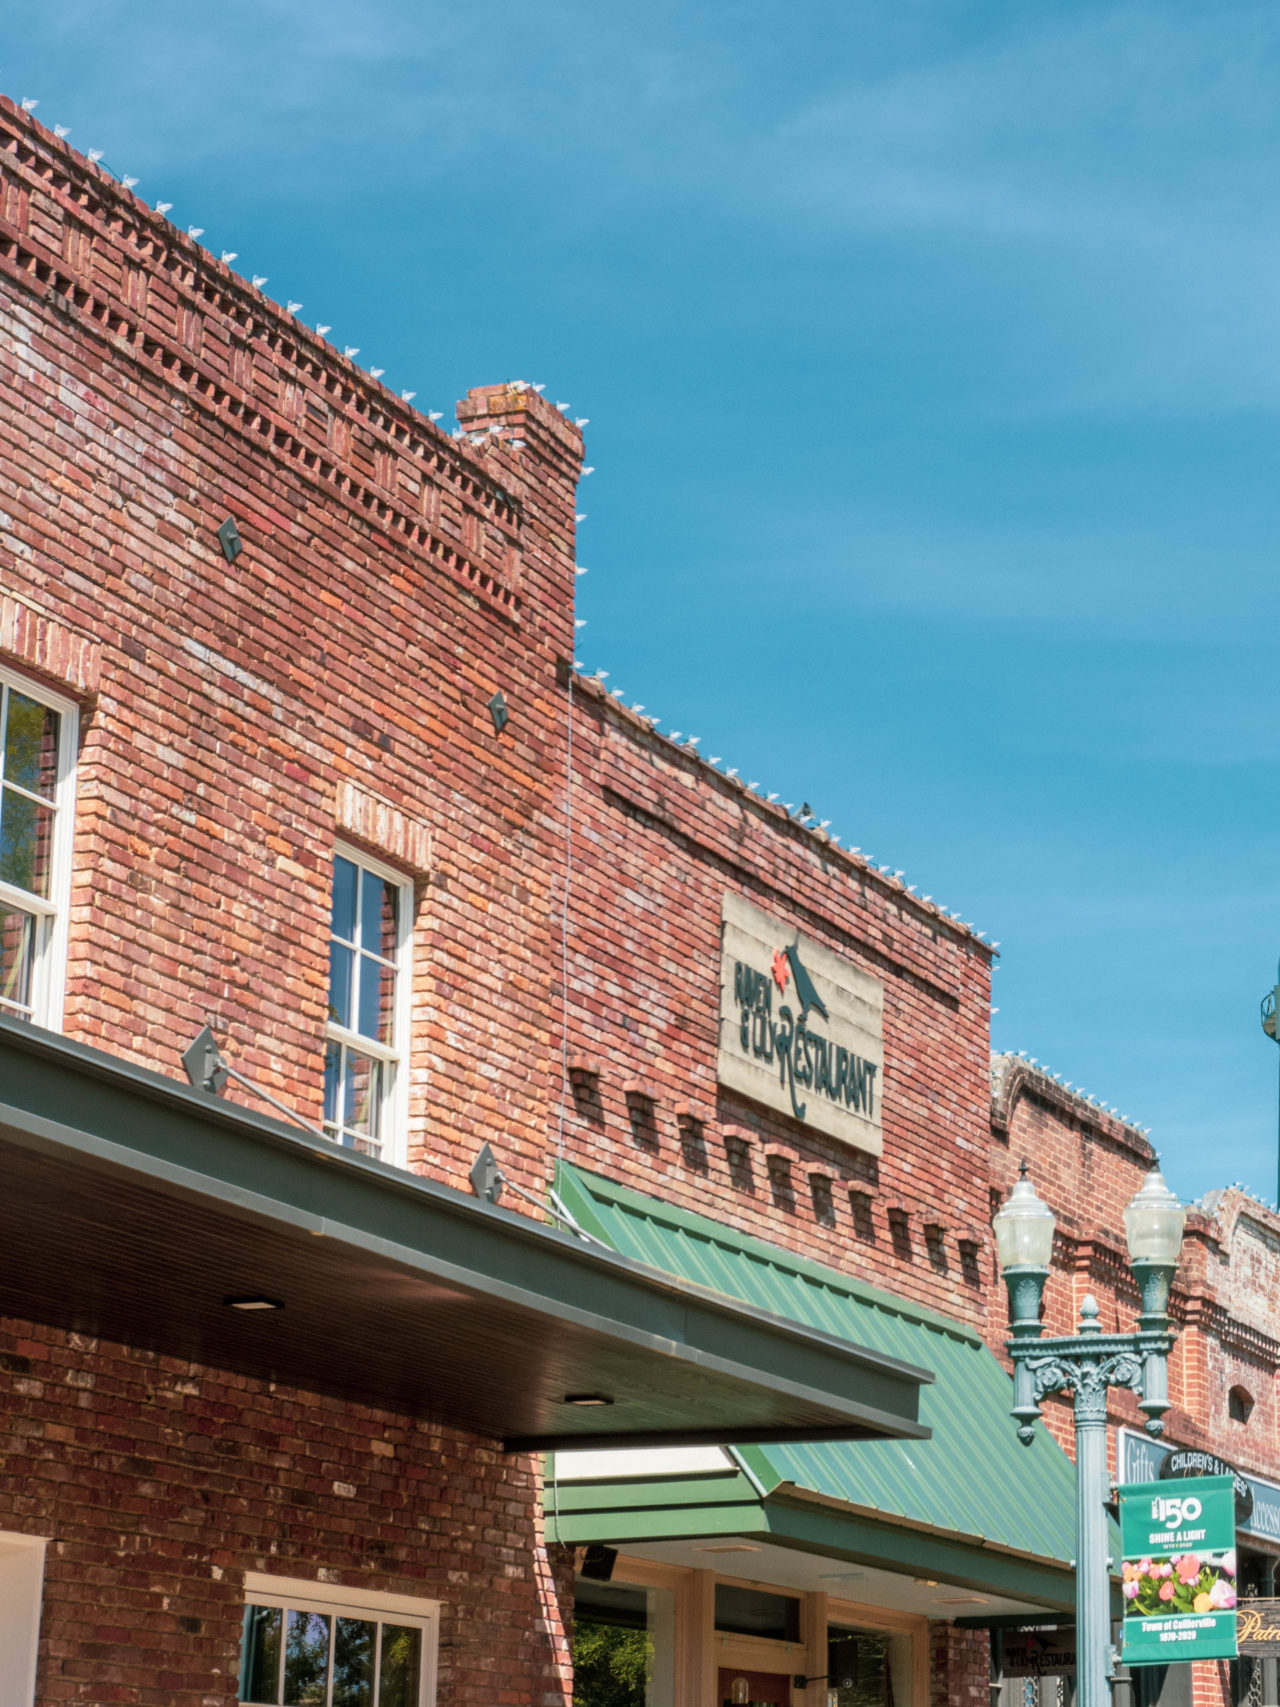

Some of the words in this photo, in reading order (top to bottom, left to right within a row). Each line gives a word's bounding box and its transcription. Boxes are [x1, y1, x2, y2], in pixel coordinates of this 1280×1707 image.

[735, 961, 772, 1016] RAVEN
[776, 1005, 877, 1121] RESTAURANT
[1127, 1439, 1155, 1484] Gifts
[1171, 1453, 1213, 1473] CHILDREN'S
[1213, 1459, 1220, 1474] &
[1149, 1531, 1175, 1544] SHINE
[1176, 1531, 1183, 1542] A
[1183, 1529, 1206, 1541] LIGHT
[1142, 1621, 1163, 1632] Town
[1163, 1620, 1172, 1631] of
[1172, 1617, 1216, 1630] Collierville
[1160, 1630, 1197, 1642] 1870-2020
